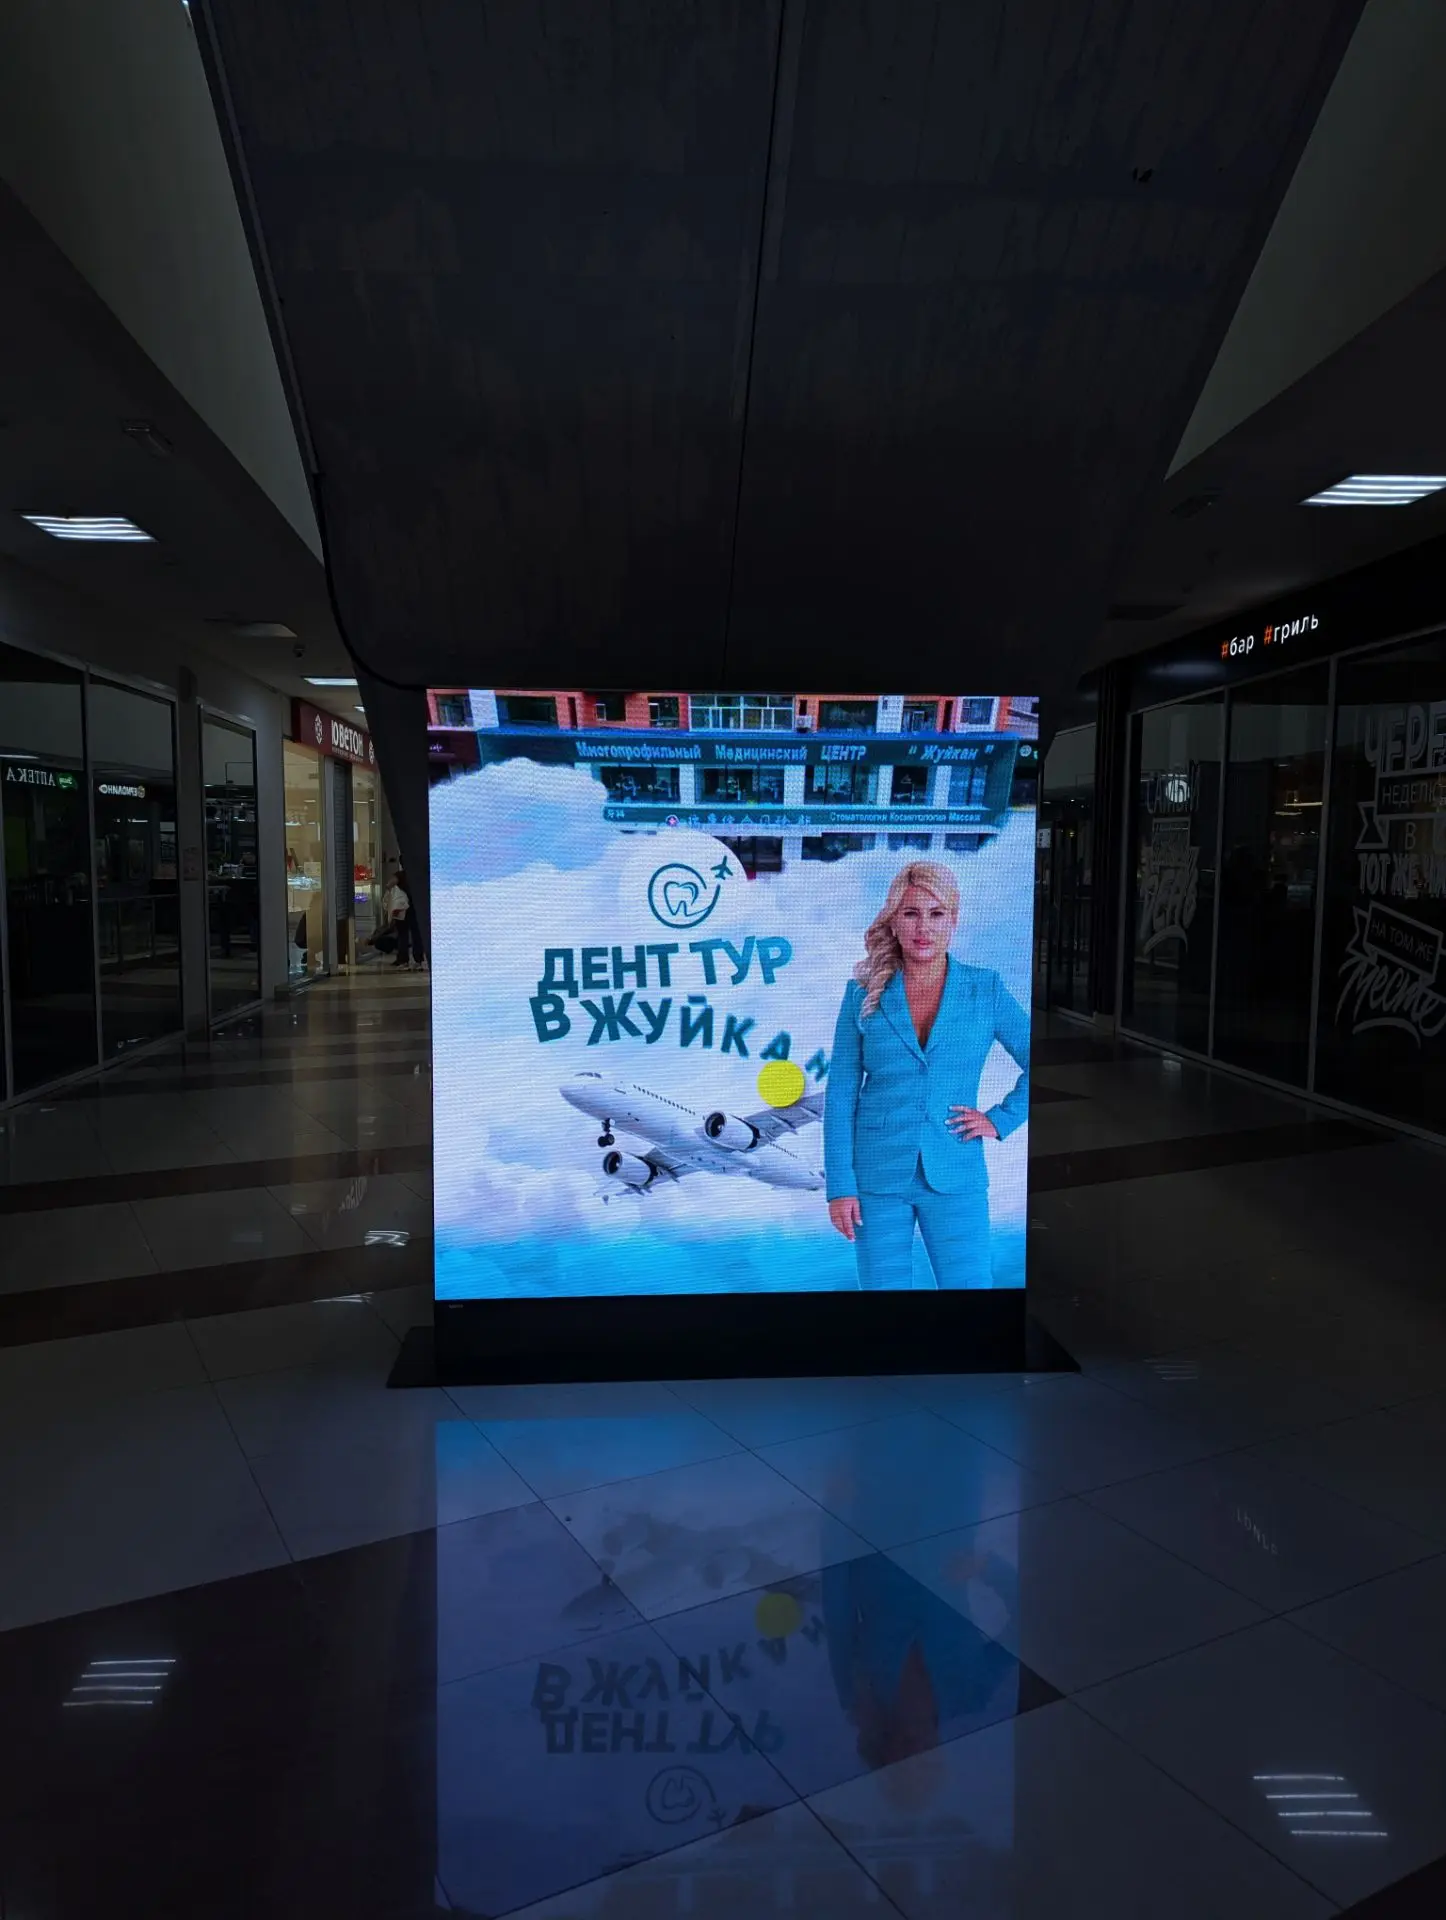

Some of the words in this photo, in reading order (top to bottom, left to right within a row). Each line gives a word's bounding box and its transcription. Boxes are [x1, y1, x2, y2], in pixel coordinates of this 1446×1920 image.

[1221, 635, 1254, 660] #бар
[1263, 613, 1319, 645] #гриль
[715, 744, 808, 762] Медицинский
[820, 745, 866, 763] ЦЕНТР
[537, 943, 679, 998] ДЕНТ
[689, 935, 793, 985] ТУР
[529, 993, 571, 1043] В
